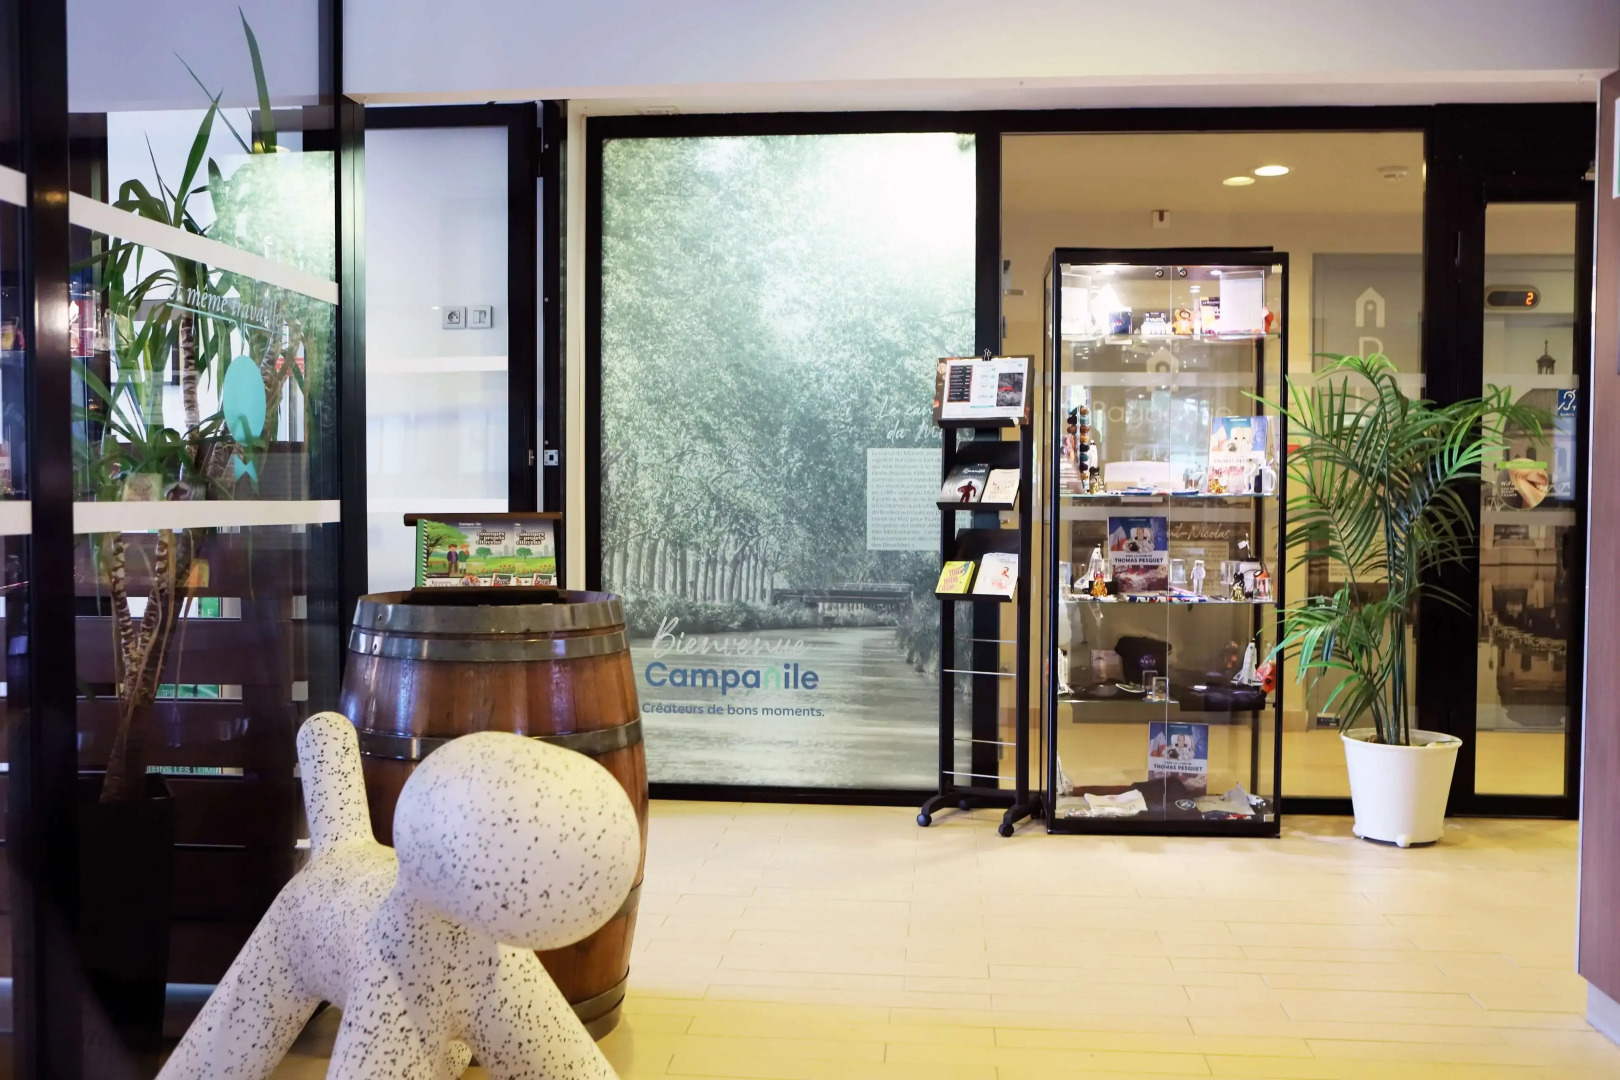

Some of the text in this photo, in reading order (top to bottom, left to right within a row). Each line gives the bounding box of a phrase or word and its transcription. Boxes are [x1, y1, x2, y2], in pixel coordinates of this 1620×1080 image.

[186, 284, 228, 313] même
[1525, 292, 1534, 306] 2
[905, 401, 934, 416] can
[652, 616, 806, 659] Bienvenue
[645, 661, 819, 695] Campanile
[642, 702, 825, 717] Créateurs de bons moments.
